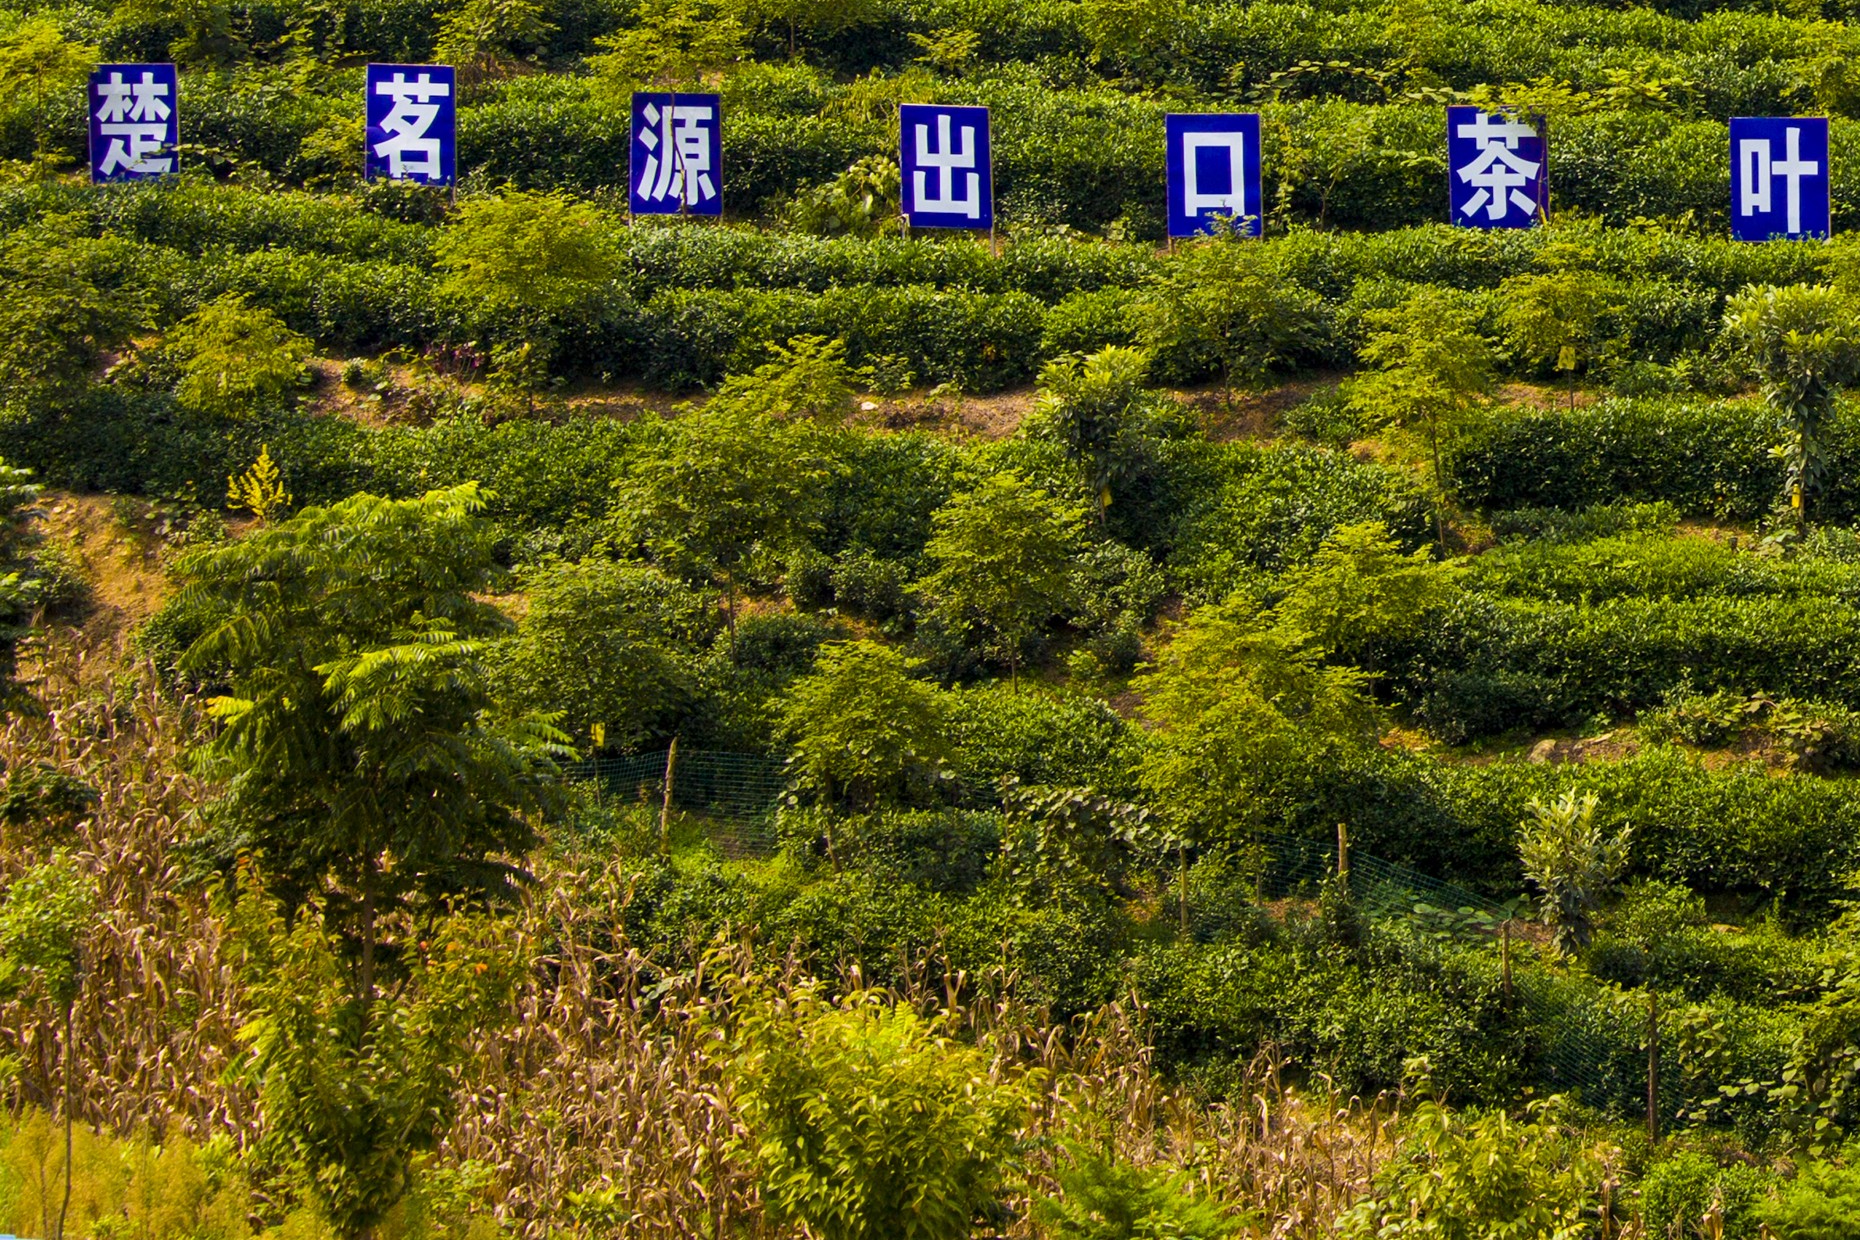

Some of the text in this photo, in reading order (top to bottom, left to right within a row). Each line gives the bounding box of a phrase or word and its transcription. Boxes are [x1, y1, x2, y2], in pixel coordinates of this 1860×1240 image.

[97, 72, 172, 175] 楚
[374, 73, 450, 180] 茗
[637, 103, 716, 205] 源
[914, 115, 981, 218] 出
[1184, 132, 1244, 216] 口
[1457, 113, 1540, 219] 茶
[1740, 128, 1818, 234] 叶
